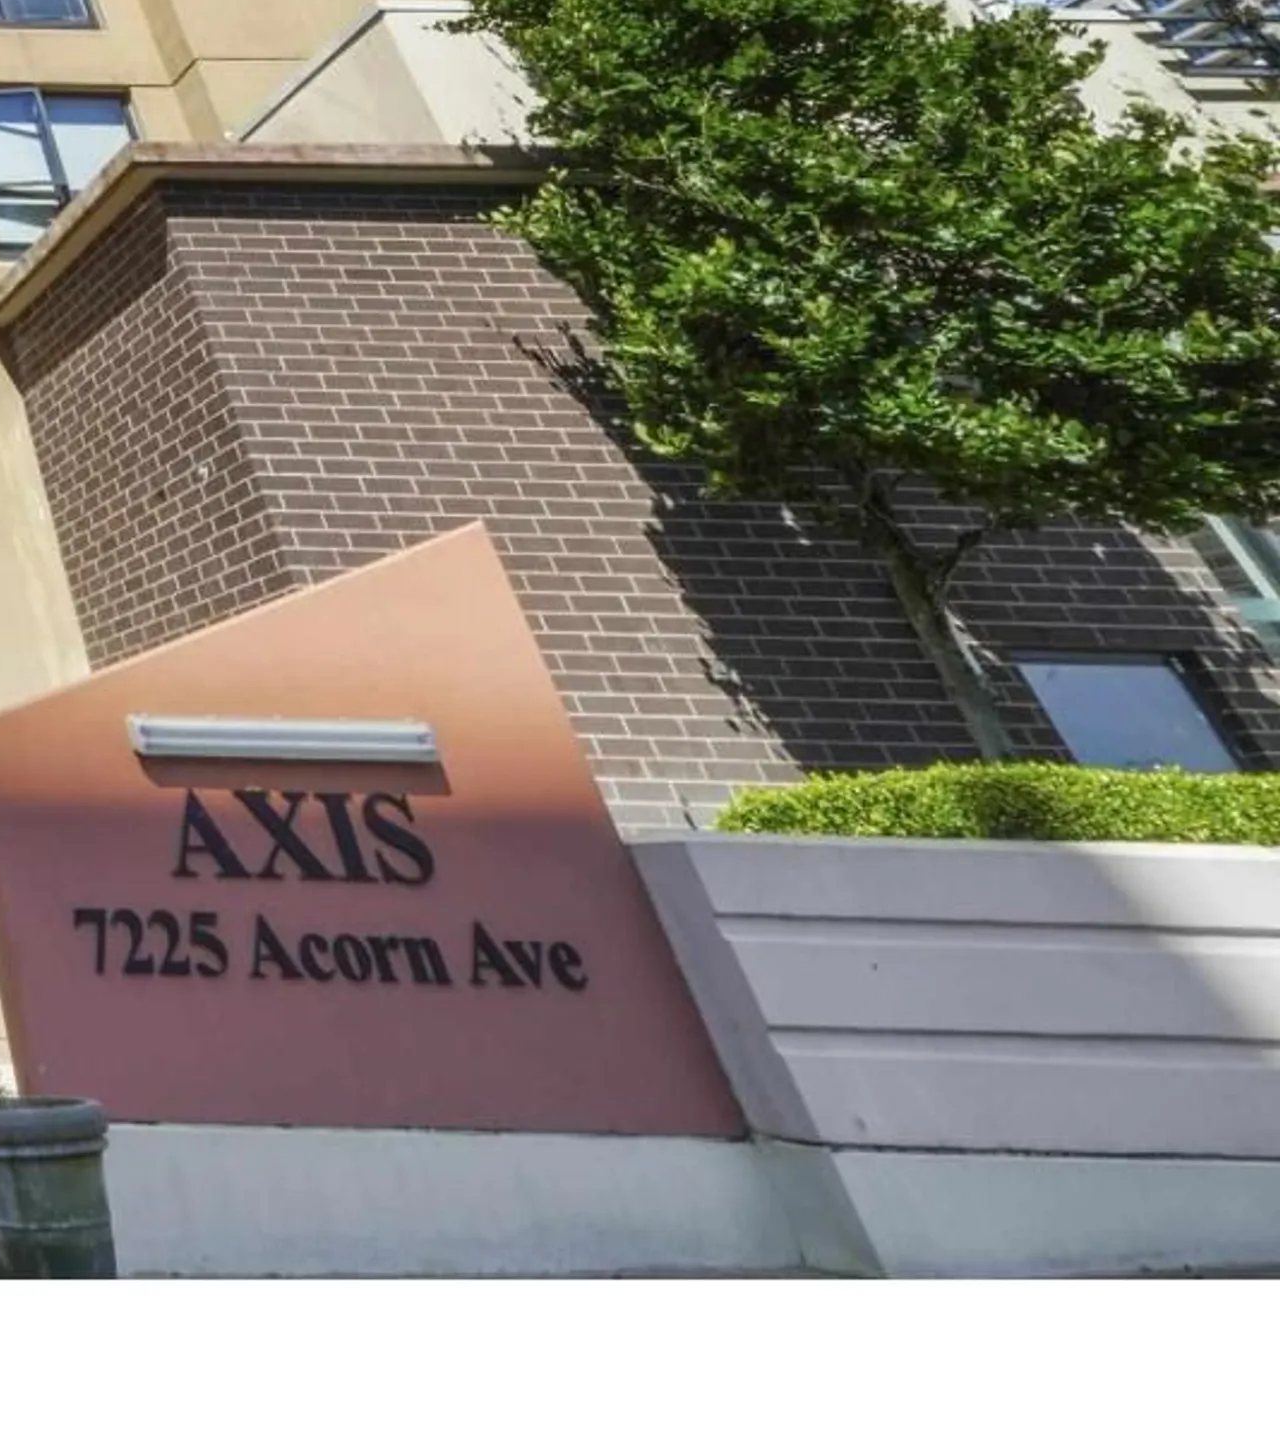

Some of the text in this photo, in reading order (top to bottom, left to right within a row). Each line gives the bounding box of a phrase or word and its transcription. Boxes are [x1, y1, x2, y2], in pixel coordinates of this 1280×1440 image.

[171, 788, 436, 887] AXIS
[72, 908, 590, 993] 7225 Acorn Ave
